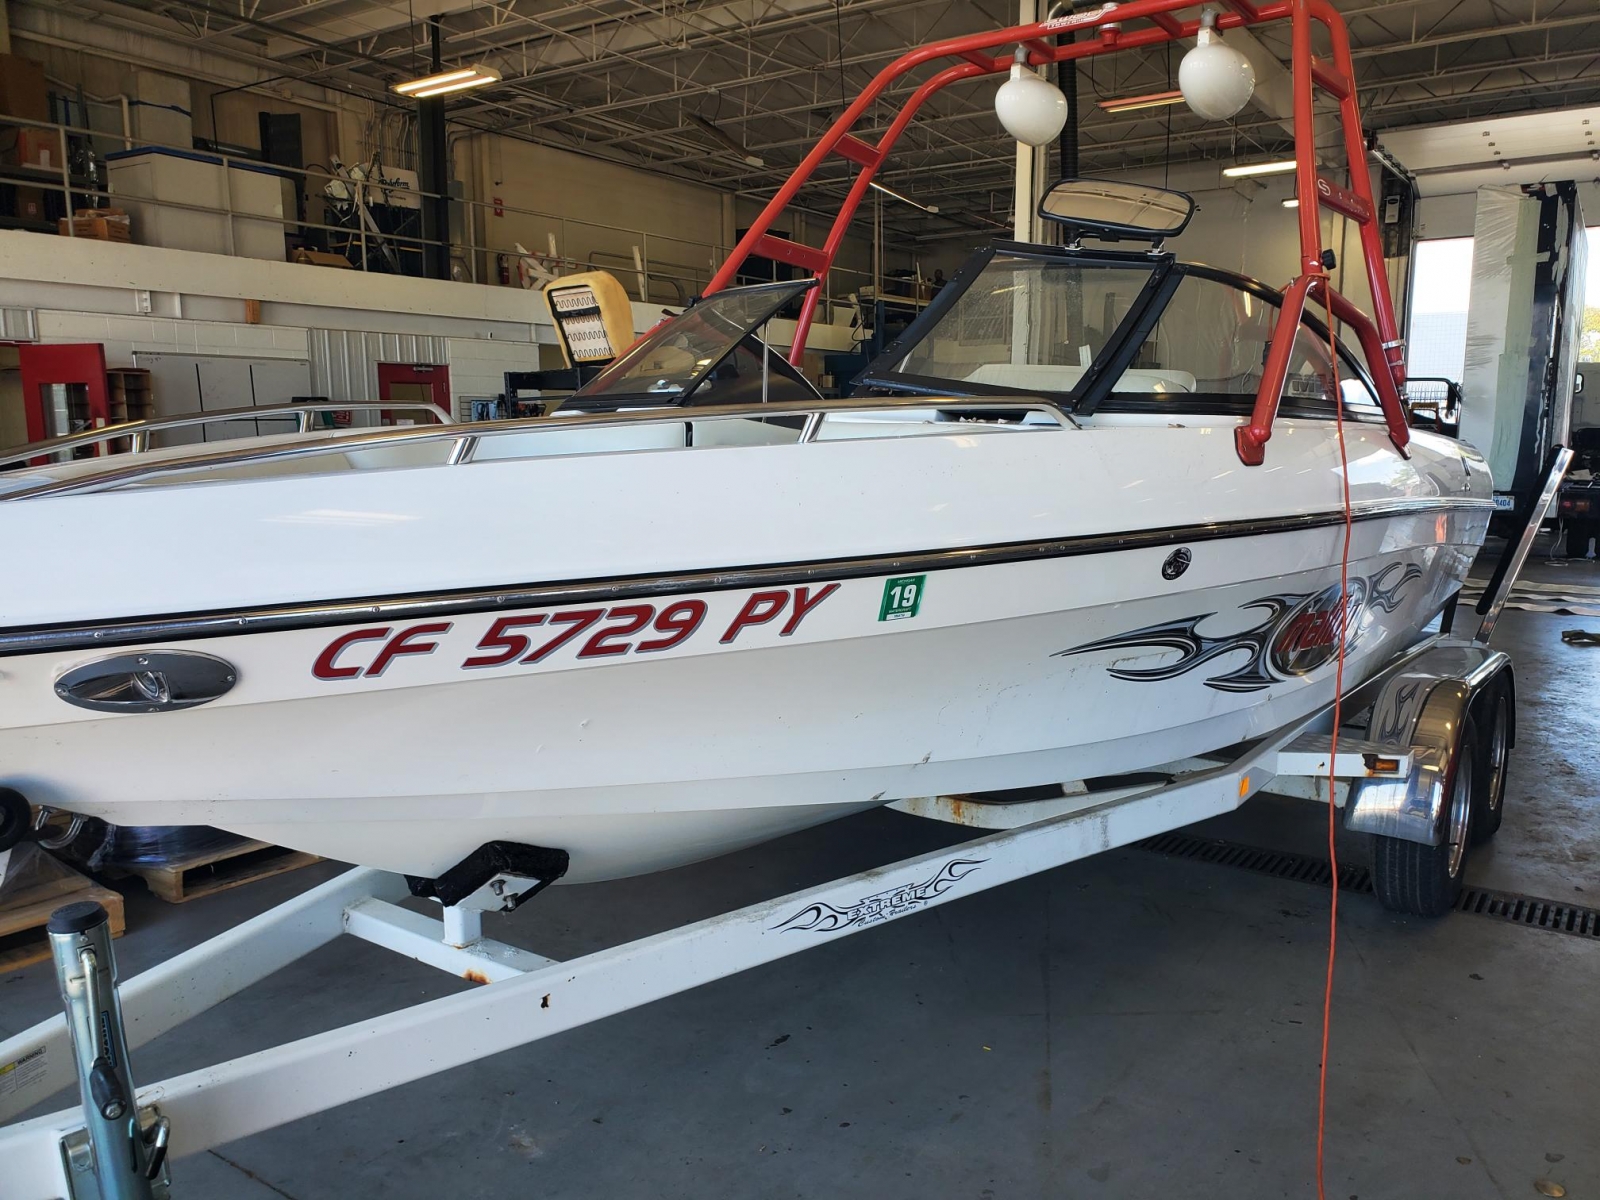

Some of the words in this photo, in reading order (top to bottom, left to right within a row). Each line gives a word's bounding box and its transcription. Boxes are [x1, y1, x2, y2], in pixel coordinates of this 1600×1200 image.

[890, 584, 917, 608] 19
[311, 621, 454, 681] CF
[461, 599, 708, 670] 5729
[719, 582, 842, 644] PY
[847, 886, 926, 920] EXTREME
